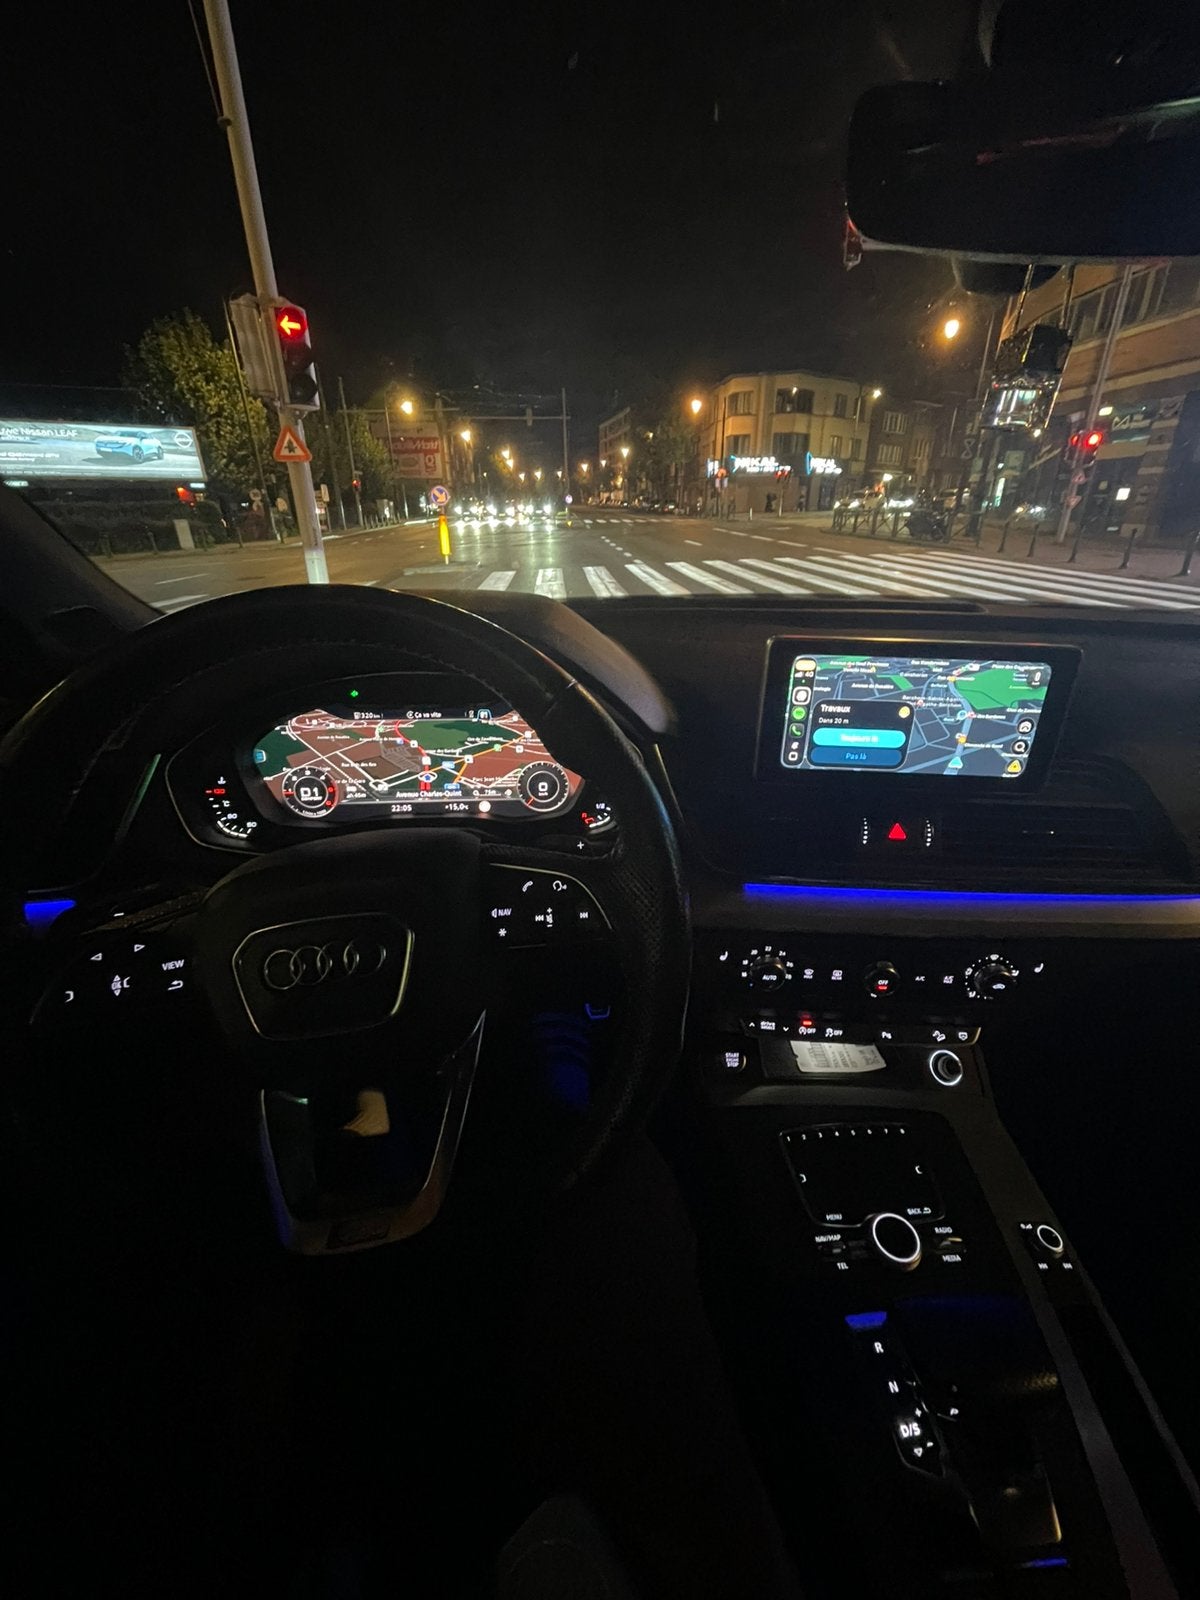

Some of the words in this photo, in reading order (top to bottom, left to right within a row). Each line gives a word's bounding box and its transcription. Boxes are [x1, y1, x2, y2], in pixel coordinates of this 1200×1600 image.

[20, 427, 54, 436] Nissan
[55, 429, 79, 438] LEAF
[820, 703, 851, 713] Travaux
[414, 711, 424, 719] Ça
[845, 752, 859, 760] Pas
[396, 790, 419, 798] Avenue
[420, 790, 462, 798] Charles-Quint
[498, 908, 512, 917] NAV
[162, 959, 185, 971] VIEW
[837, 1261, 849, 1270] TEL
[874, 1341, 884, 1353] R
[888, 1380, 899, 1393] N
[900, 1421, 921, 1438] D/S
